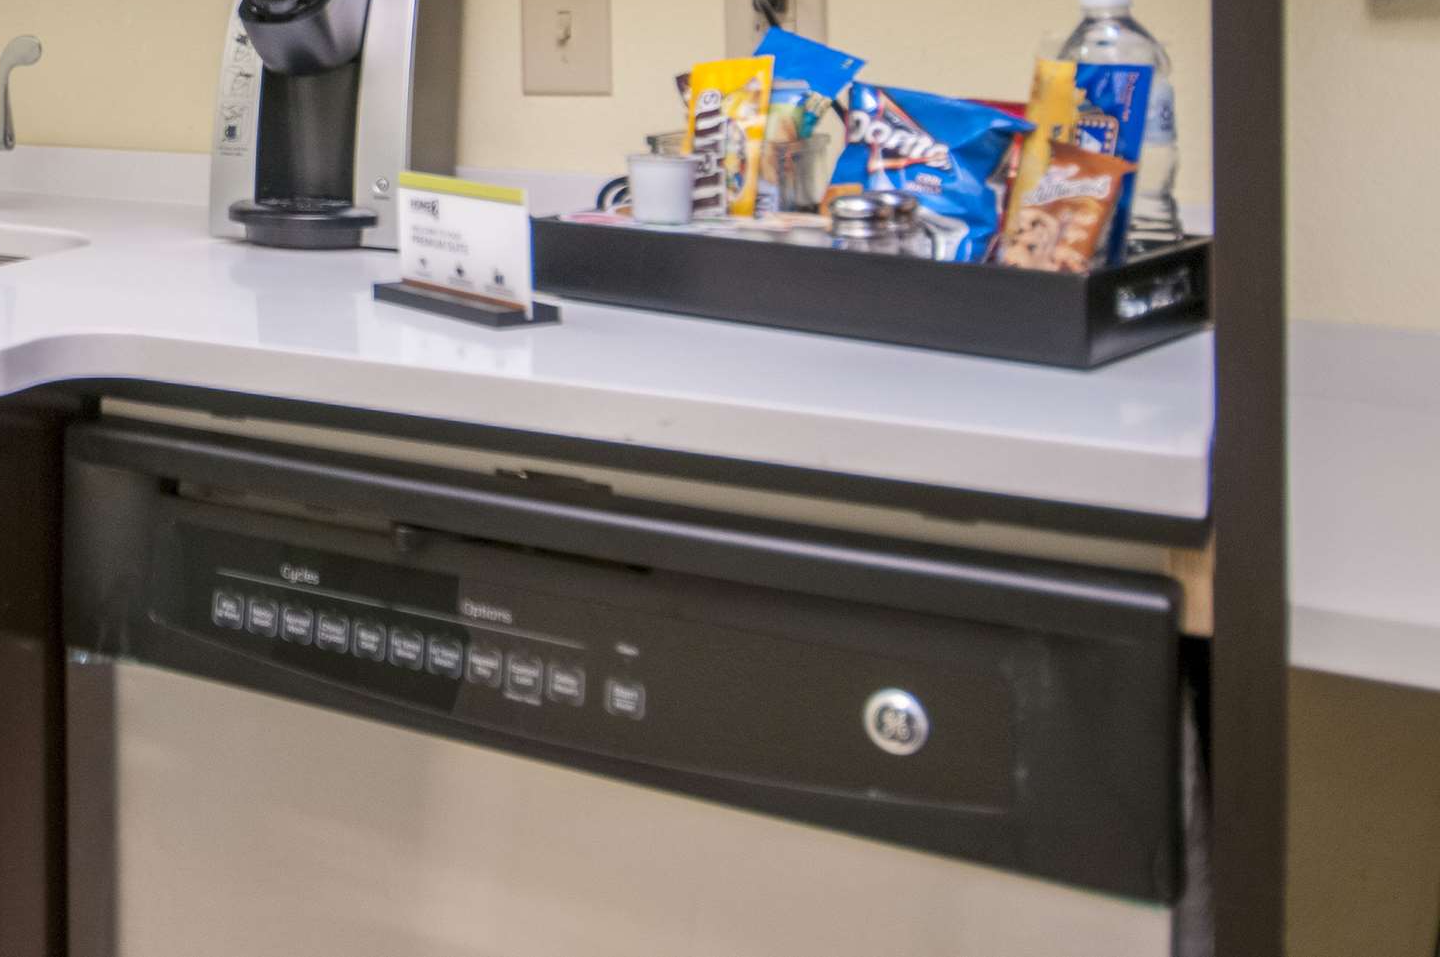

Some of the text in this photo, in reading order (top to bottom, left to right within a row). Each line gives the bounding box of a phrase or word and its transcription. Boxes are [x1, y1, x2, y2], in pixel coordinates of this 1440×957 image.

[847, 110, 953, 171] Doritos
[280, 563, 320, 585] Cycles
[463, 600, 513, 626] Options
